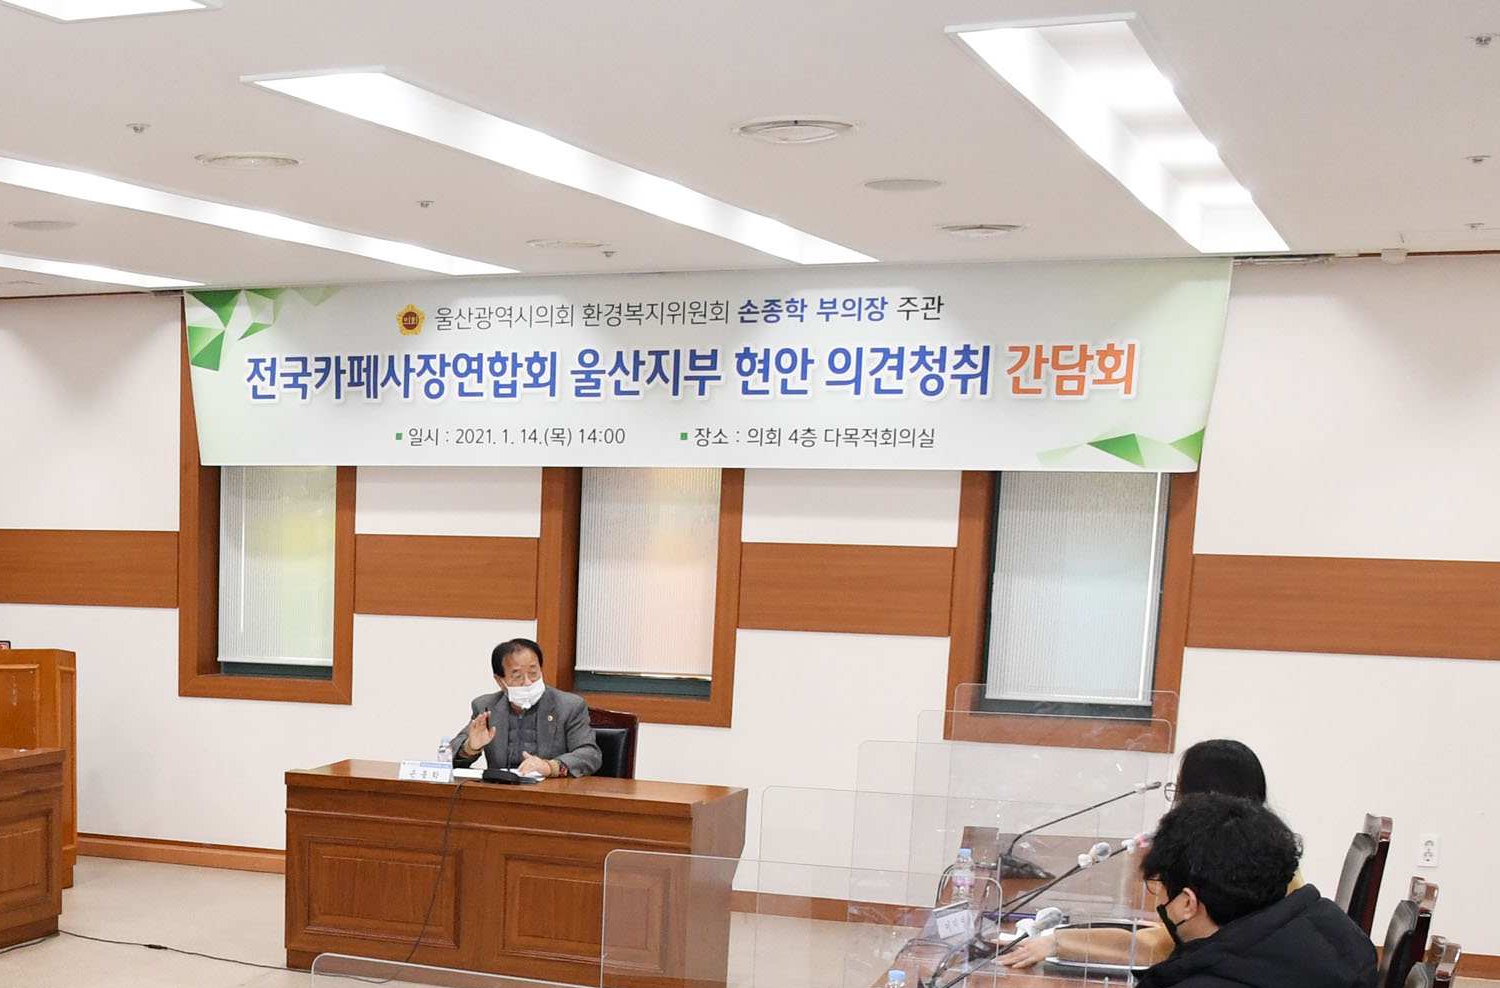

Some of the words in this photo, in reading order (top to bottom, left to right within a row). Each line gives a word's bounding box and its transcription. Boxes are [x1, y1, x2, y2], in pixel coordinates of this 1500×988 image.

[403, 316, 419, 325] 의회
[435, 304, 574, 331] 울산광역시의회
[582, 299, 729, 328] 환경복지위원회
[737, 297, 809, 325] 손종학
[816, 296, 888, 322] 부의장
[897, 296, 945, 321] 주관
[245, 350, 558, 401] 전국카페사장연합회
[570, 348, 722, 398] 울산지부
[734, 346, 815, 396] 현안
[826, 345, 991, 396] 의견청취
[1007, 343, 1136, 395] 간담회
[408, 427, 440, 446] 일시
[455, 427, 497, 445] 2021.
[521, 426, 572, 446] 14.(목)
[578, 427, 626, 445] 14:00
[694, 427, 729, 446] 장소
[746, 427, 782, 447] 의회
[788, 428, 818, 447] 4층
[823, 427, 936, 447] 다목적회의실
